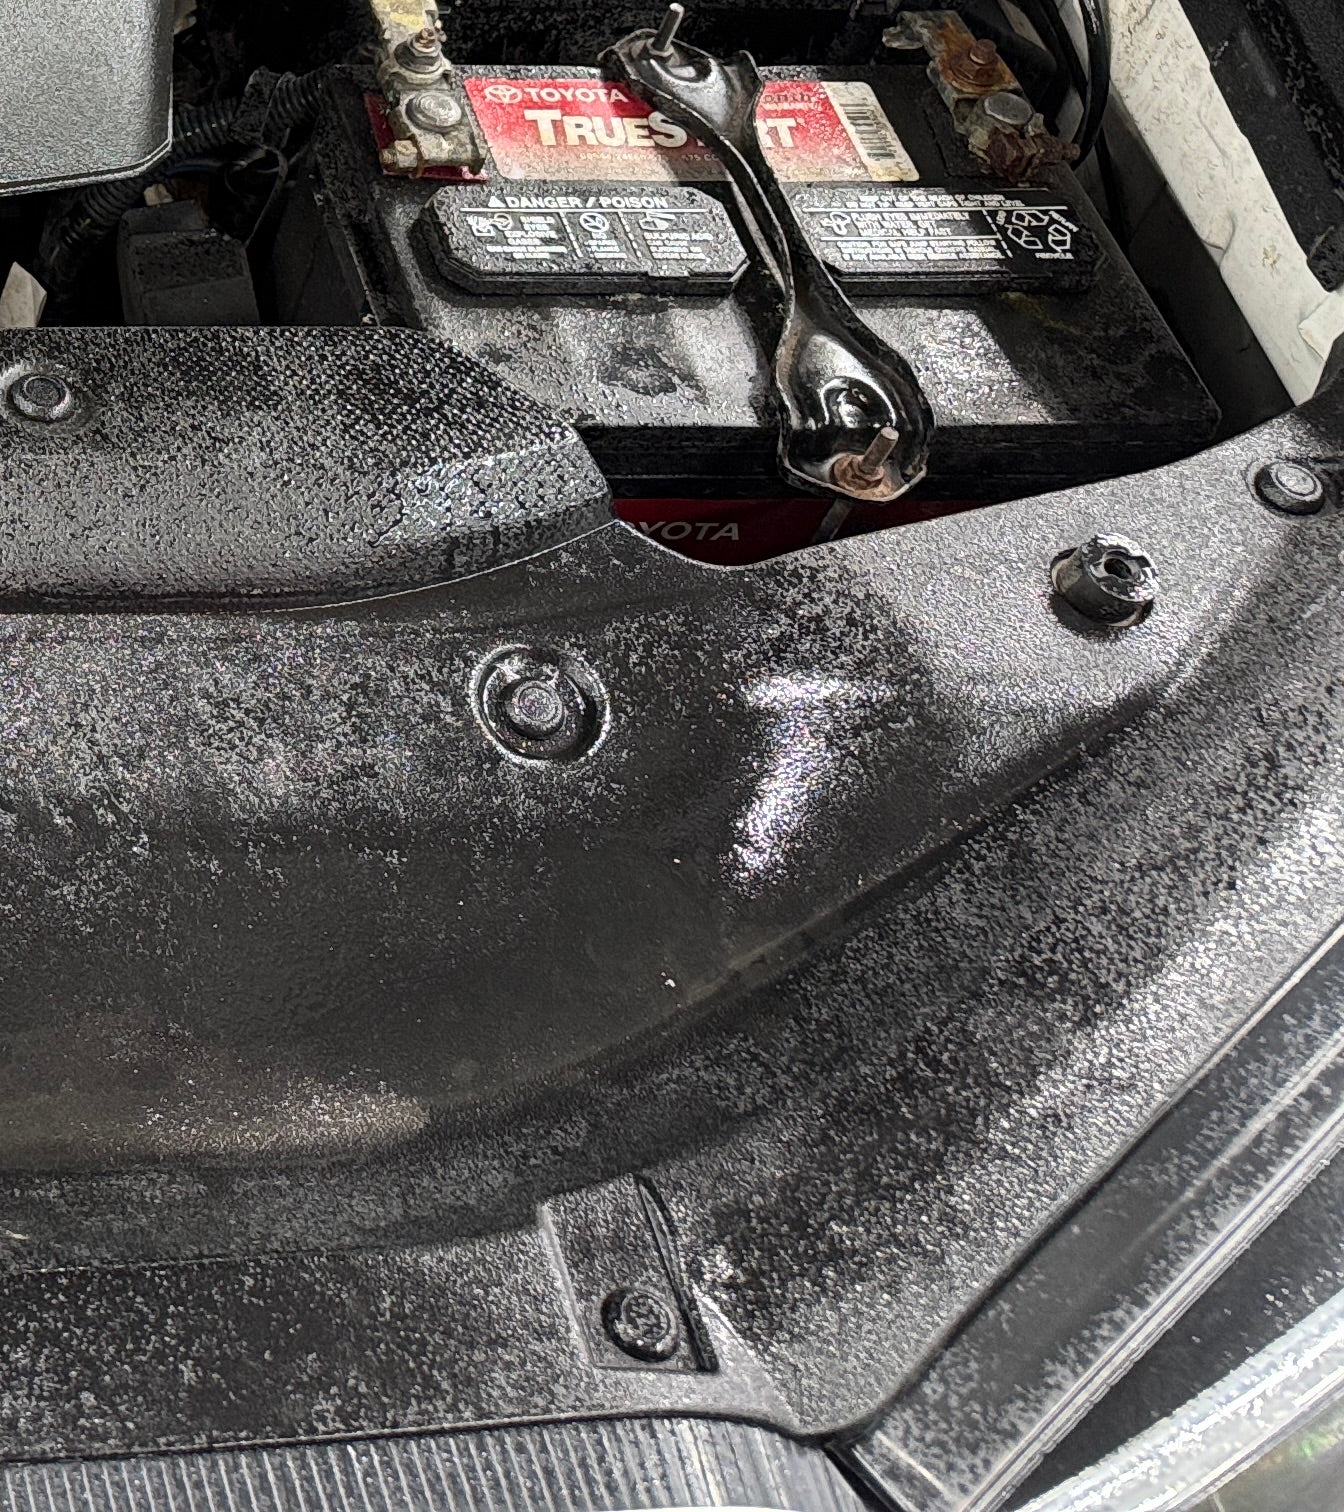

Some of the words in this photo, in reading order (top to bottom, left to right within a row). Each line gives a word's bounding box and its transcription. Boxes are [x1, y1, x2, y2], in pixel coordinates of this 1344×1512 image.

[523, 87, 629, 103] TOYOTA
[505, 197, 582, 208] DANGER
[598, 196, 669, 208] POISON
[628, 521, 740, 541] YOTA
